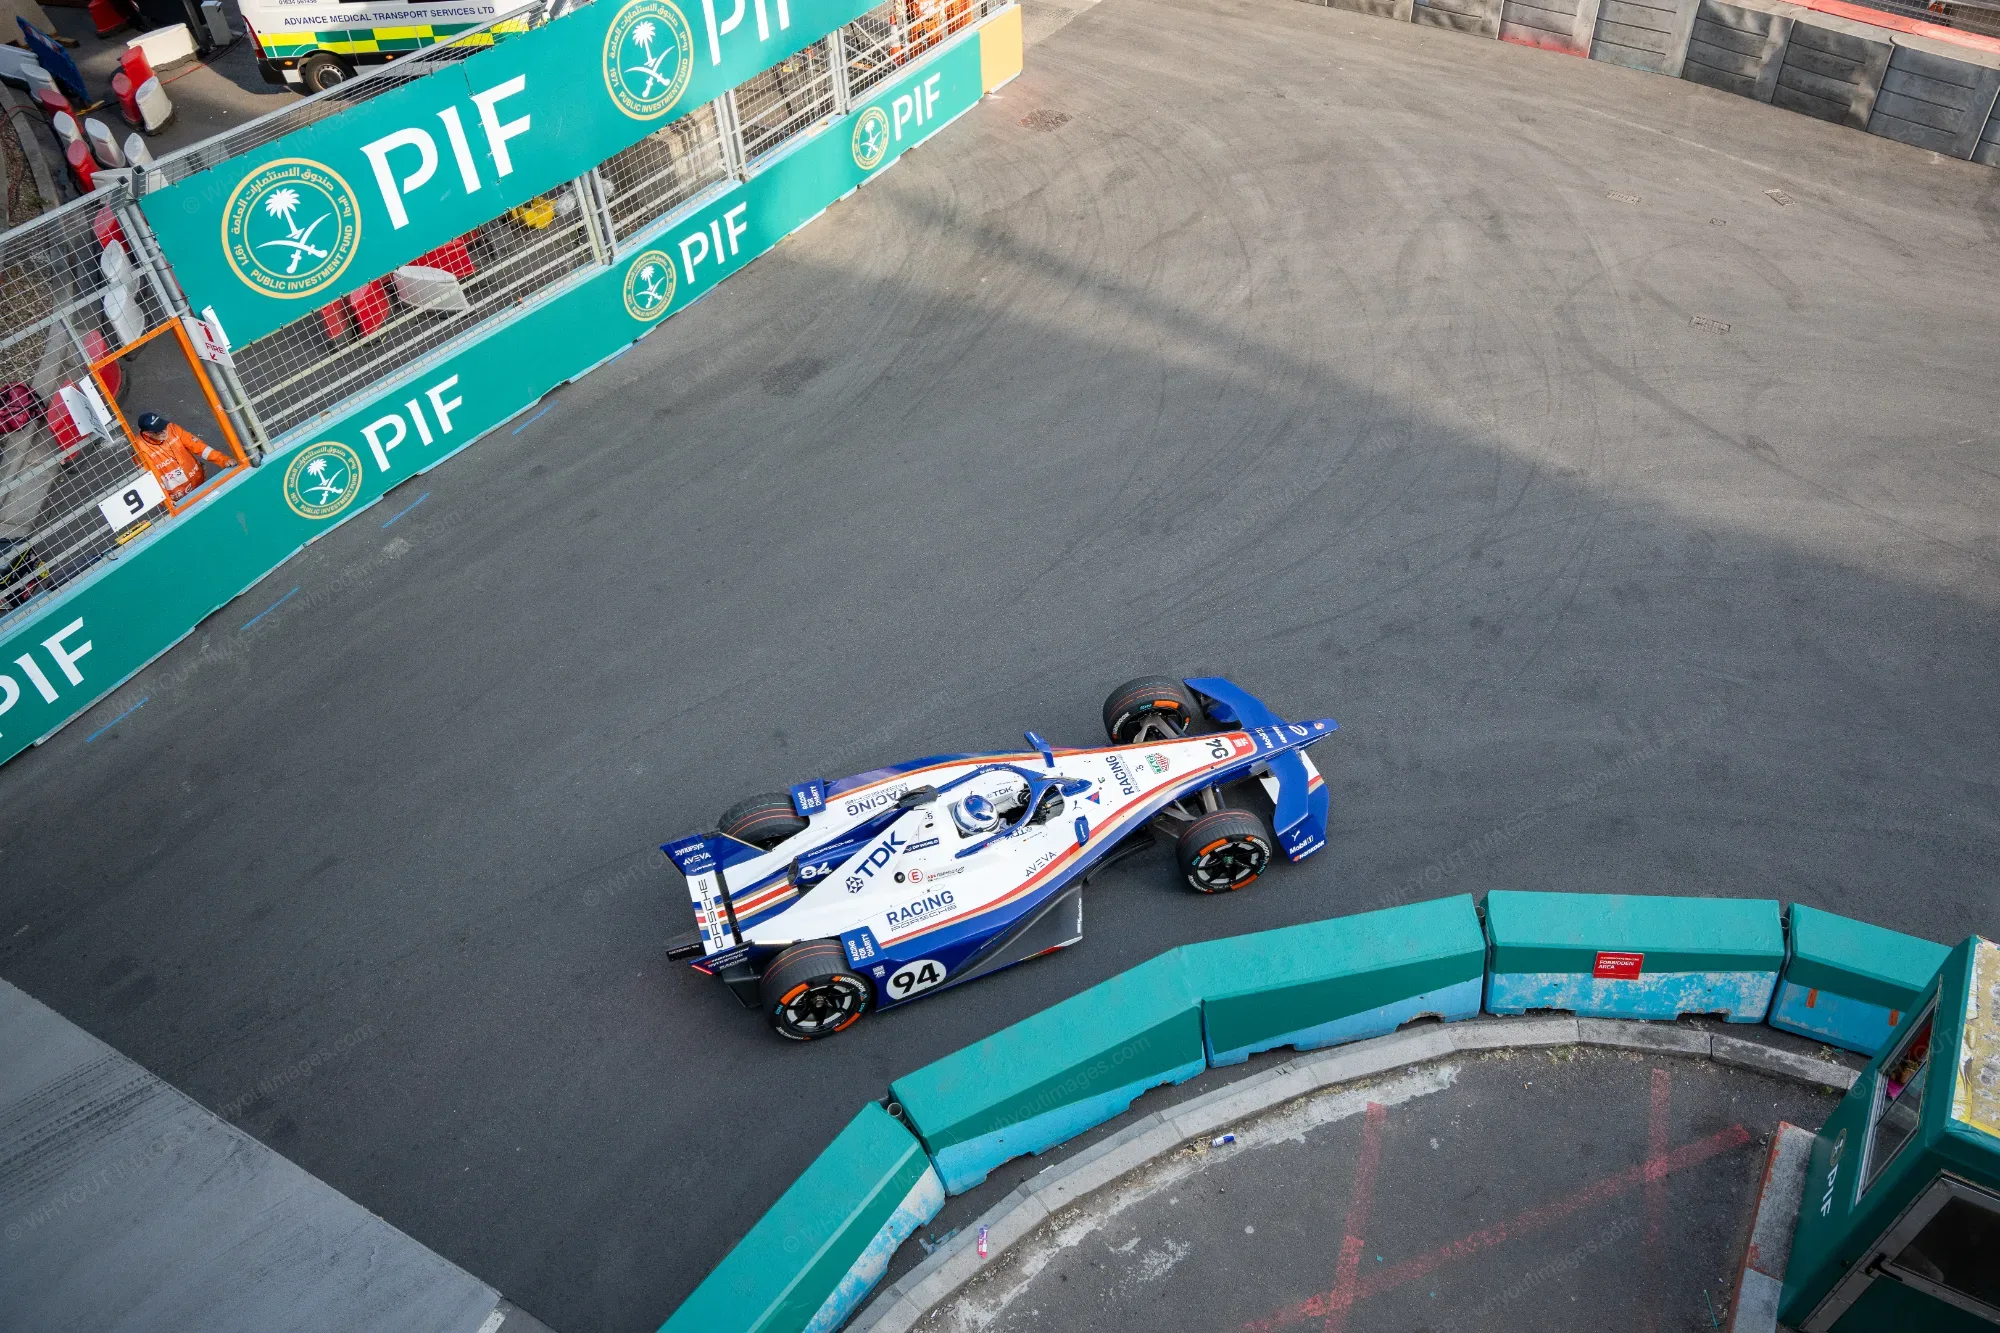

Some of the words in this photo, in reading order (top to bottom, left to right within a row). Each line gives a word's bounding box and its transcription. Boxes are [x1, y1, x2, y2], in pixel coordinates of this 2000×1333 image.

[284, 16, 328, 26] ADVANCE
[330, 13, 371, 23] MEDICAL
[373, 10, 428, 21] TRANSPORT
[431, 7, 476, 18] SERVICES
[478, 6, 495, 14] LTD
[618, 91, 641, 112] PUBLIC
[642, 82, 680, 112] INVESTMENT
[677, 58, 688, 83] FUND
[892, 72, 941, 140] PIF
[360, 74, 530, 230] PIF
[234, 244, 250, 266] 1971
[251, 269, 286, 290] PUBLIC
[288, 253, 344, 290] INVESTMENT
[340, 225, 353, 253] FUND
[678, 201, 748, 284] PIF
[360, 374, 462, 472] PIF
[123, 489, 144, 515] 9
[290, 492, 299, 504] 1971
[300, 504, 320, 514] PUBLIC
[320, 490, 353, 514] INVESTMENT
[992, 786, 1014, 797] TDK
[1105, 755, 1135, 796] RACING
[683, 852, 712, 866] AVEVA
[854, 830, 906, 878] TDK
[1026, 851, 1056, 877] AVEVA
[698, 879, 723, 949] ORSCHE
[886, 890, 954, 926] RACING
[892, 962, 940, 994] 94
[1820, 1163, 1838, 1217] PIF
